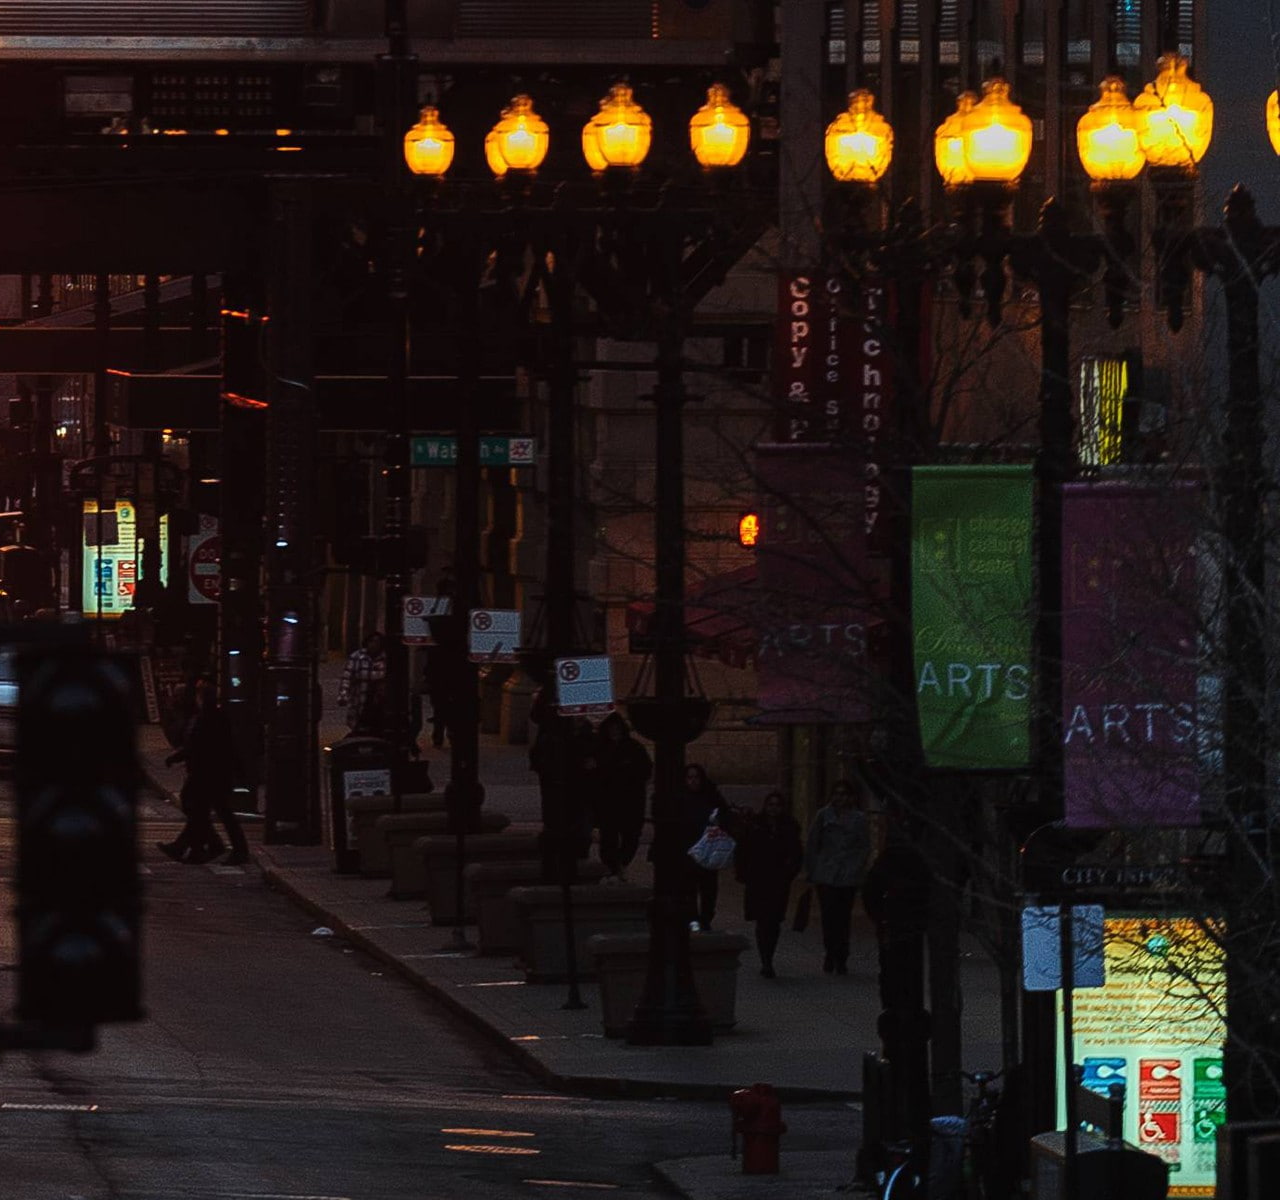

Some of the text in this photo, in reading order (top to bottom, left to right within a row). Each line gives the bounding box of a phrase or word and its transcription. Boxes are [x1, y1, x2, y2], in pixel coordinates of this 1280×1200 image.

[790, 276, 811, 368] Copy
[917, 661, 1031, 700] ARTS
[1064, 704, 1195, 744] ARTS
